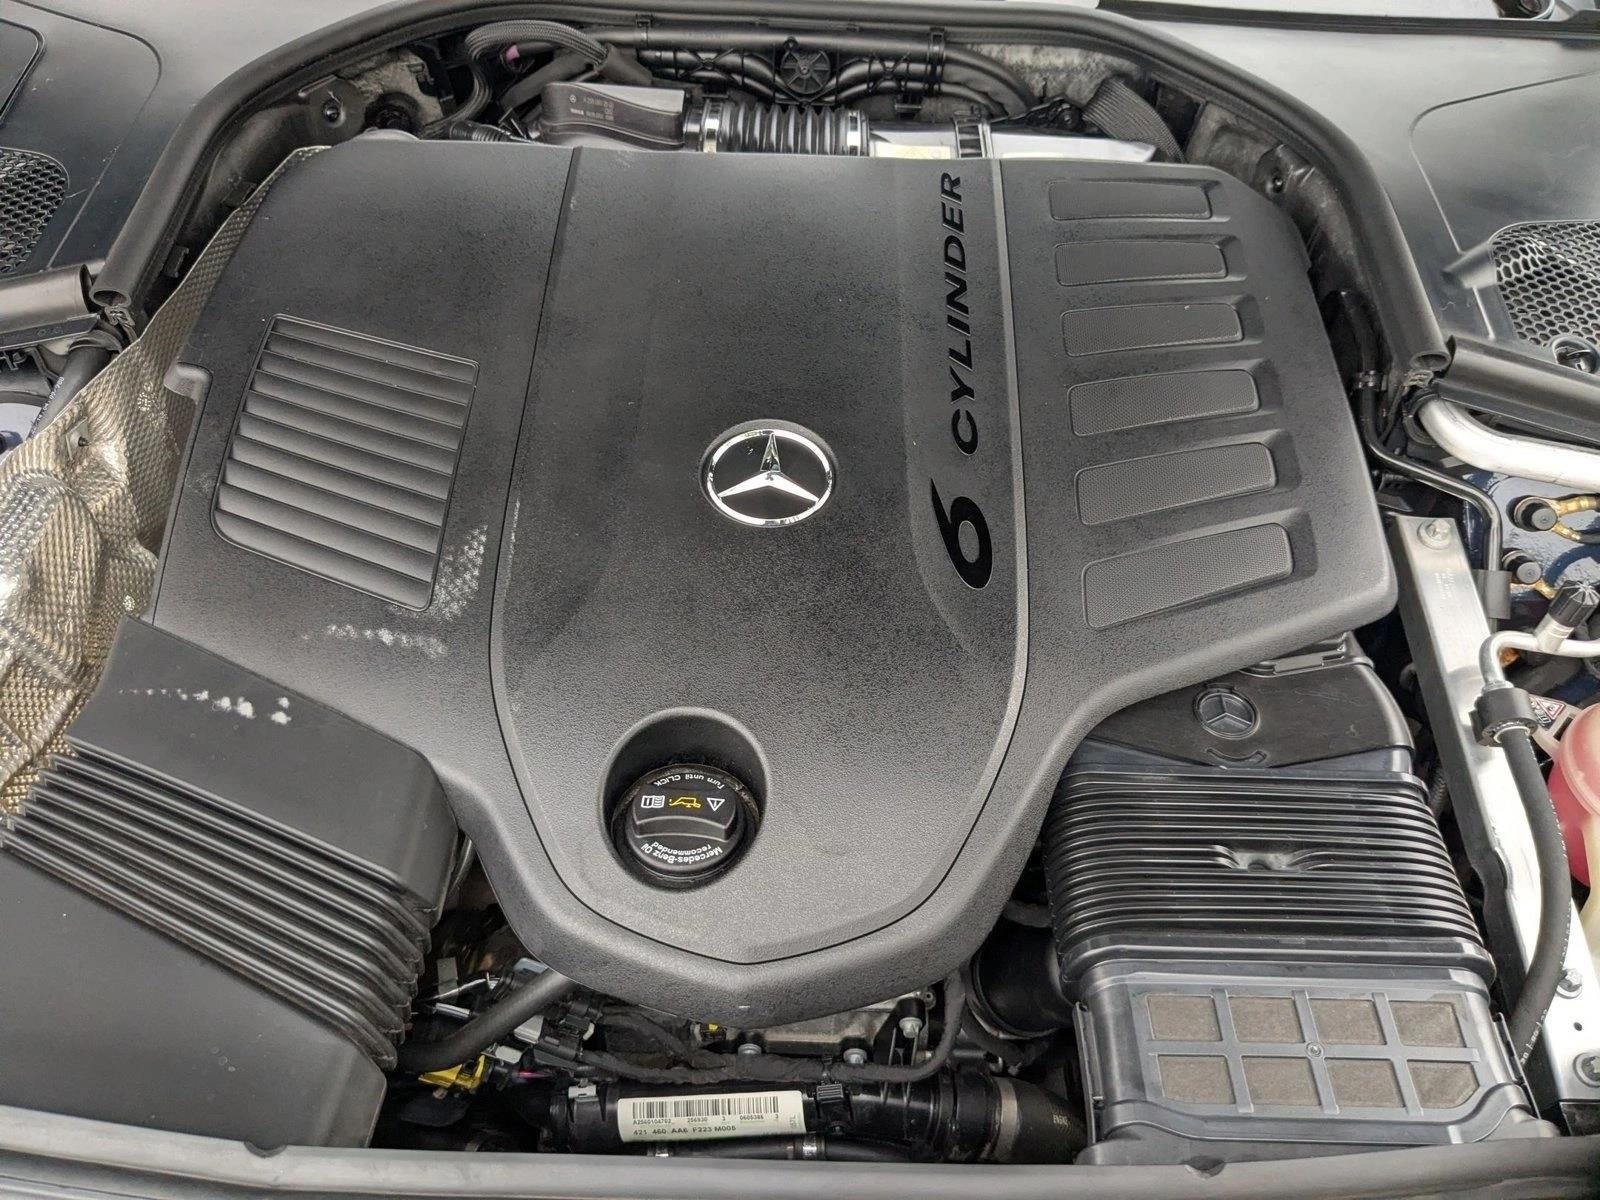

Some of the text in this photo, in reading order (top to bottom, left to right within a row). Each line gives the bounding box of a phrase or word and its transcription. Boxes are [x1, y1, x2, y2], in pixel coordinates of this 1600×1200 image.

[930, 172, 993, 590] 6 CYLINDER
[653, 774, 681, 787] CLICK
[707, 777, 725, 789] Turn
[641, 843, 723, 864] Mercedes-Benz Oil
[652, 841, 712, 856] recommended
